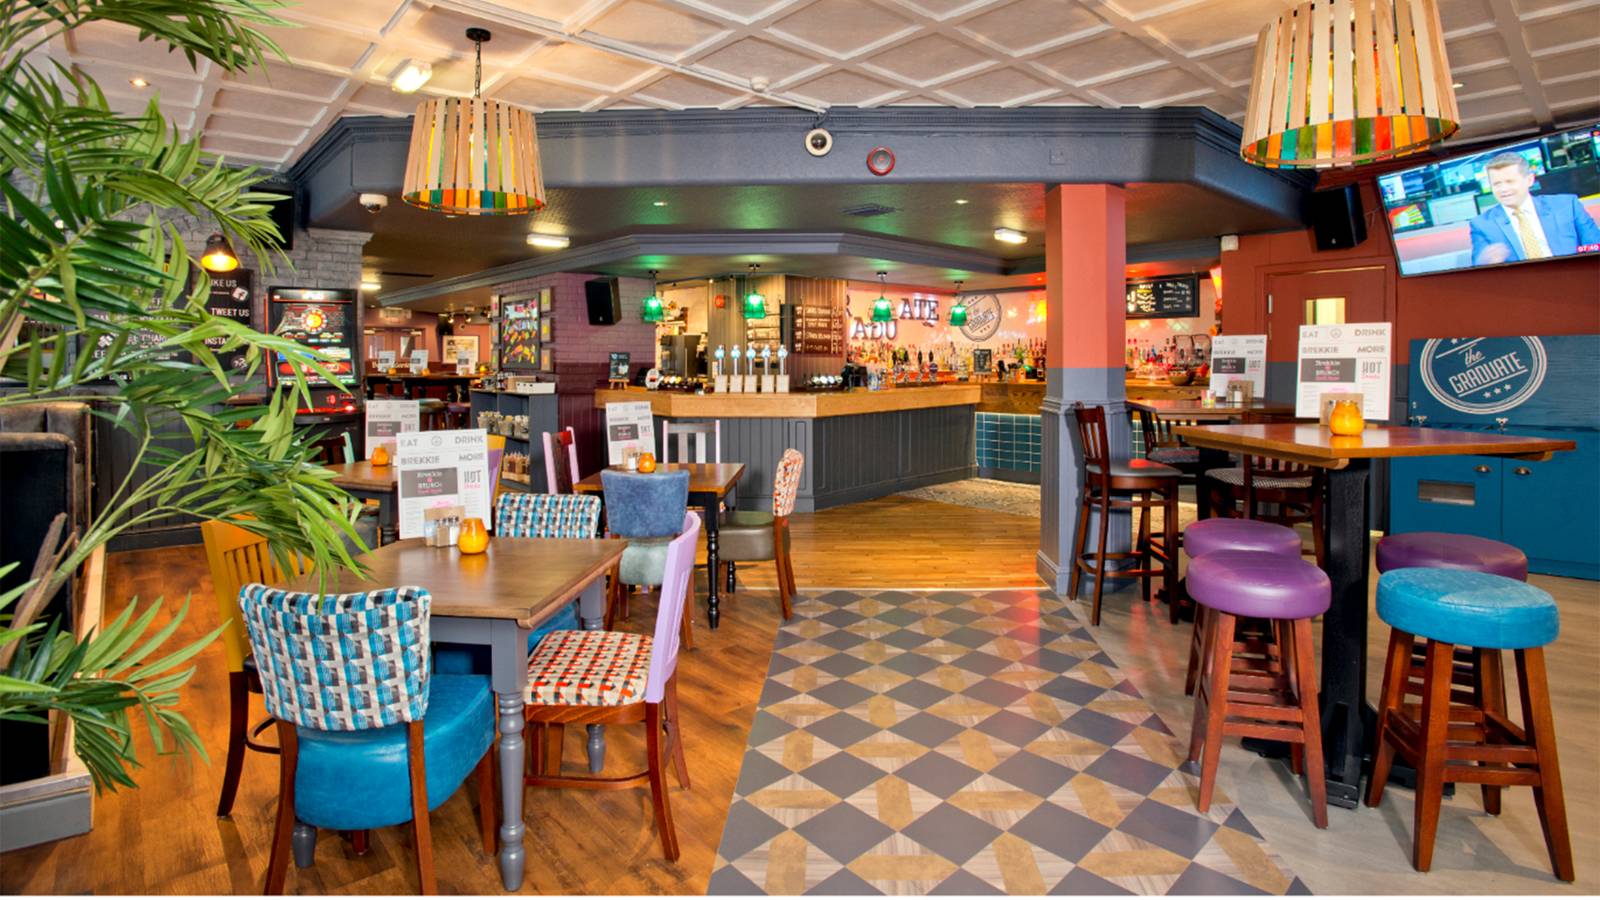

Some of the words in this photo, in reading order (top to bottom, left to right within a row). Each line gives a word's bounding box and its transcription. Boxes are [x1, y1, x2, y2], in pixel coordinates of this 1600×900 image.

[211, 279, 225, 287] IKE
[225, 279, 237, 288] US
[211, 307, 237, 317] TWEET
[238, 308, 250, 317] US
[1354, 328, 1386, 337] DRINK
[1464, 348, 1483, 366] the
[1448, 351, 1526, 394] GRADUATE
[401, 438, 419, 448] EAT
[455, 435, 484, 445] DRINK
[401, 456, 440, 465] BREKKIE
